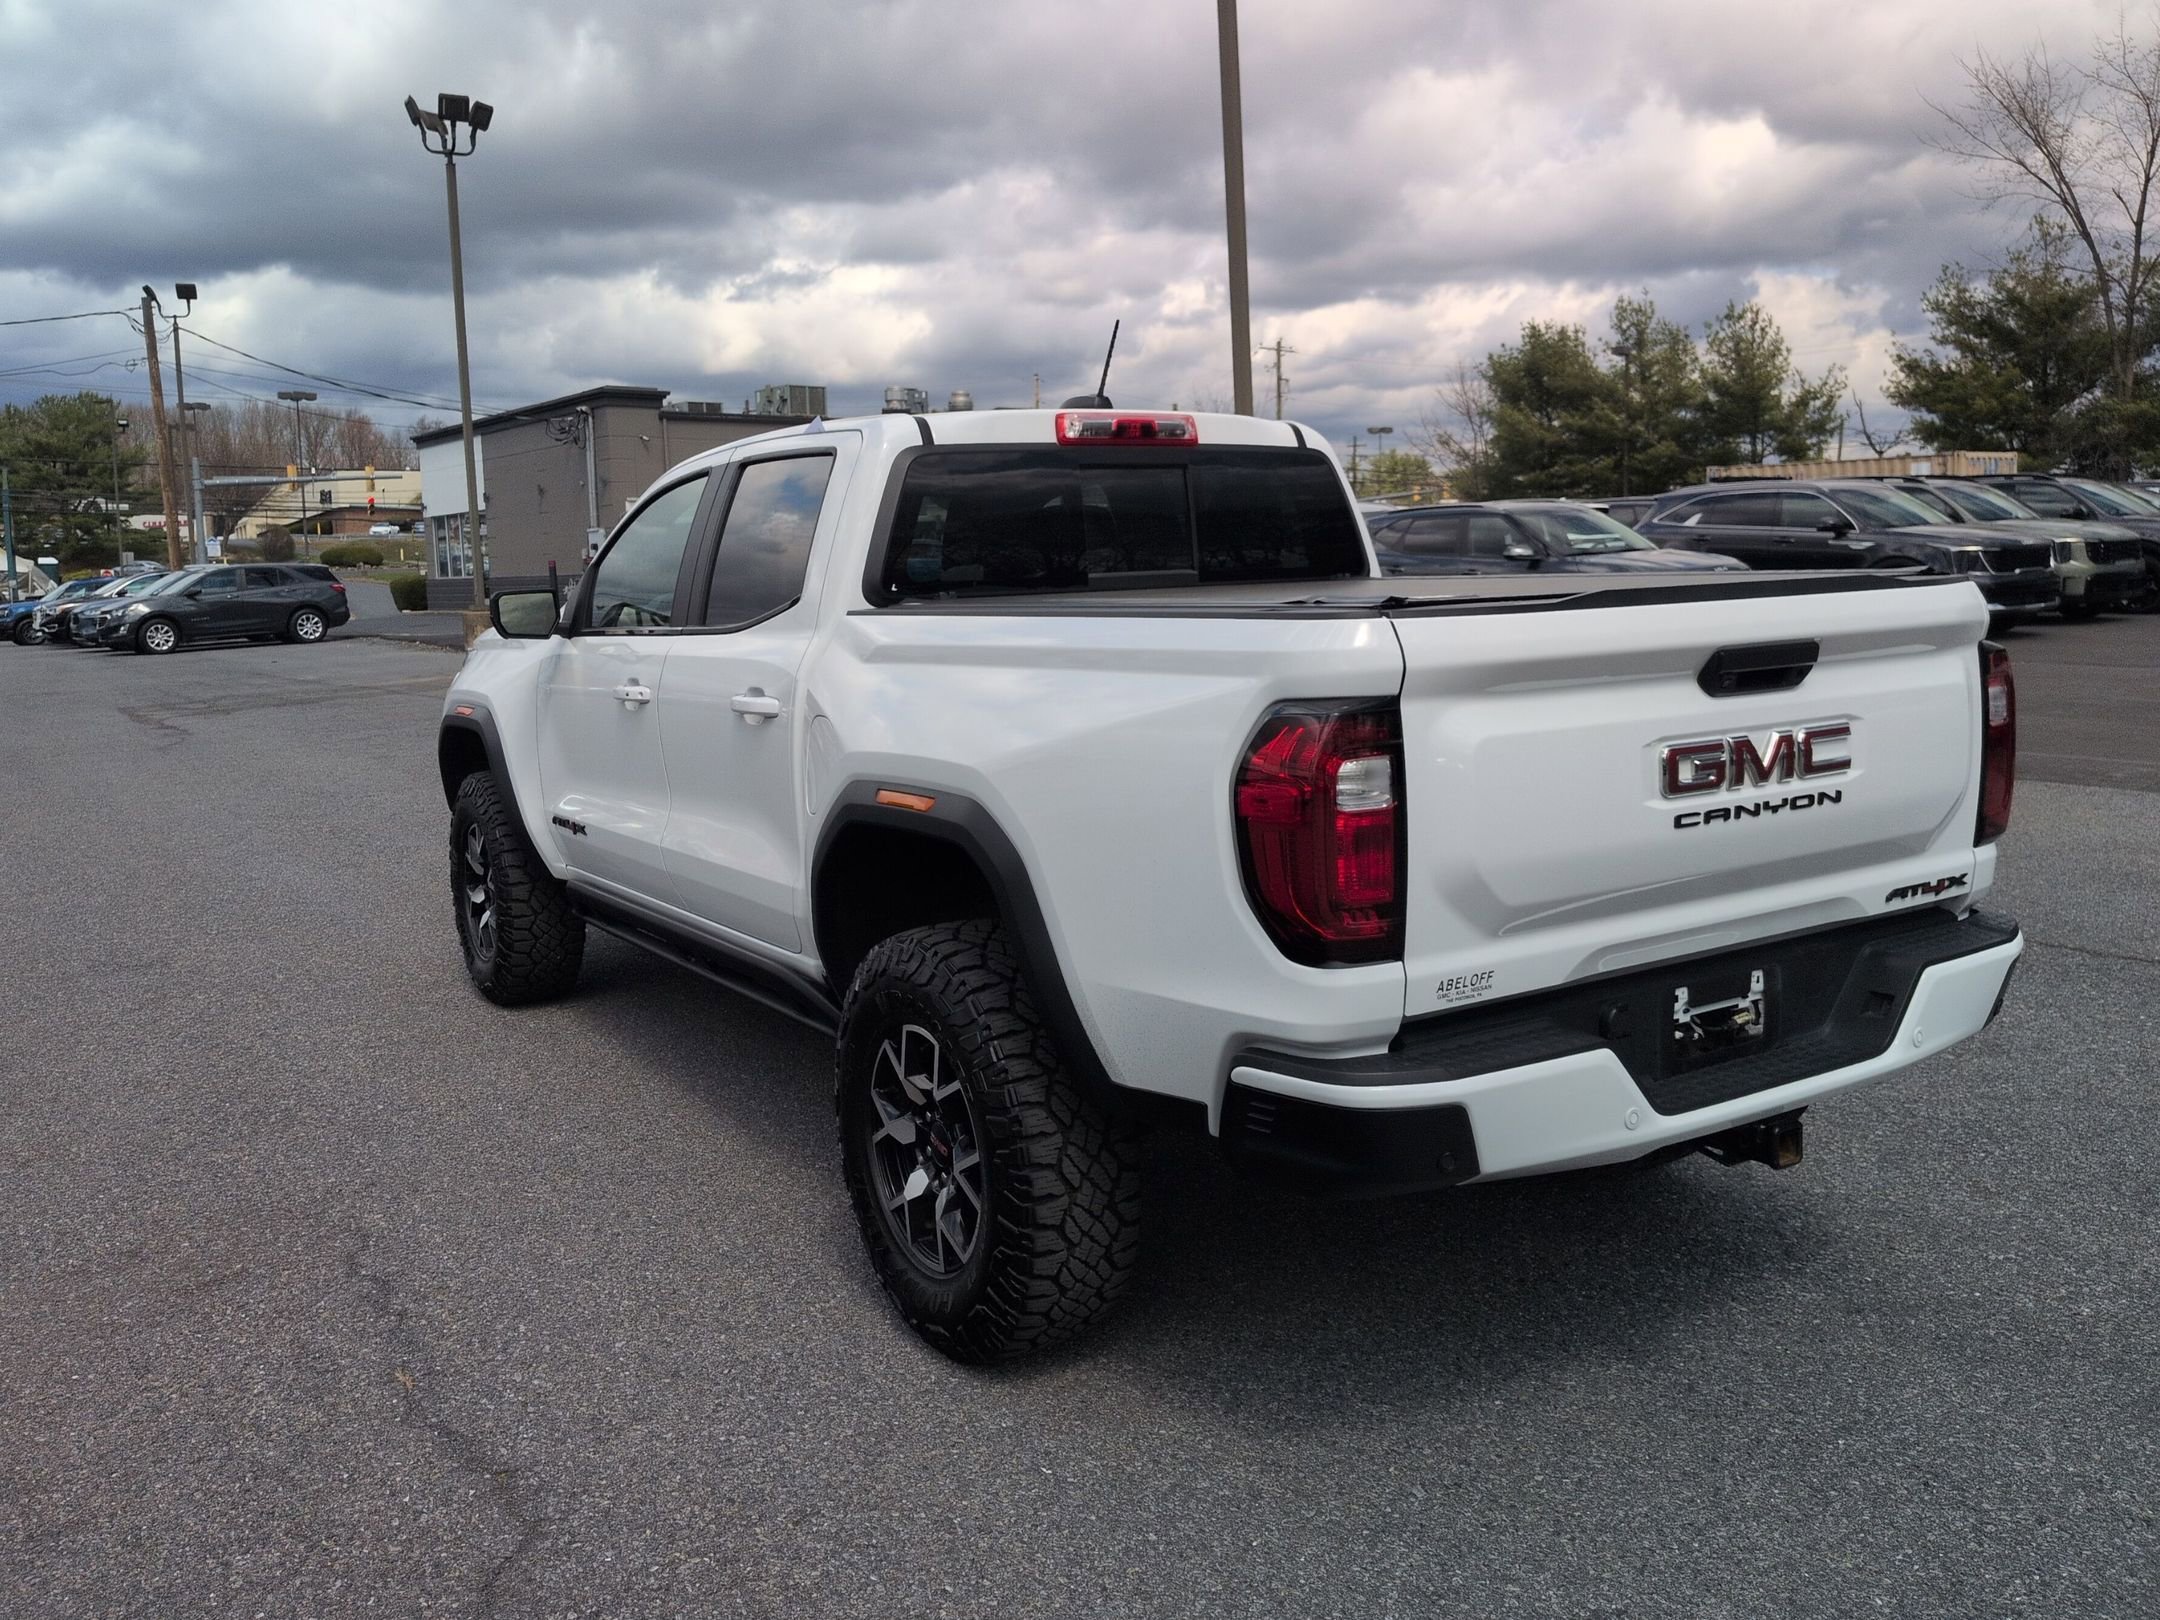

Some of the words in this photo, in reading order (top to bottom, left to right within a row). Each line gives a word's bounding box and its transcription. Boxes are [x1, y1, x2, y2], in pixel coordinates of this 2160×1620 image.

[1660, 722, 1851, 798] GMC
[1674, 790, 1842, 829] CANYON
[1885, 872, 1968, 903] AT4X
[1436, 970, 1495, 993] ABELOFF
[1437, 992, 1451, 1000] GMC
